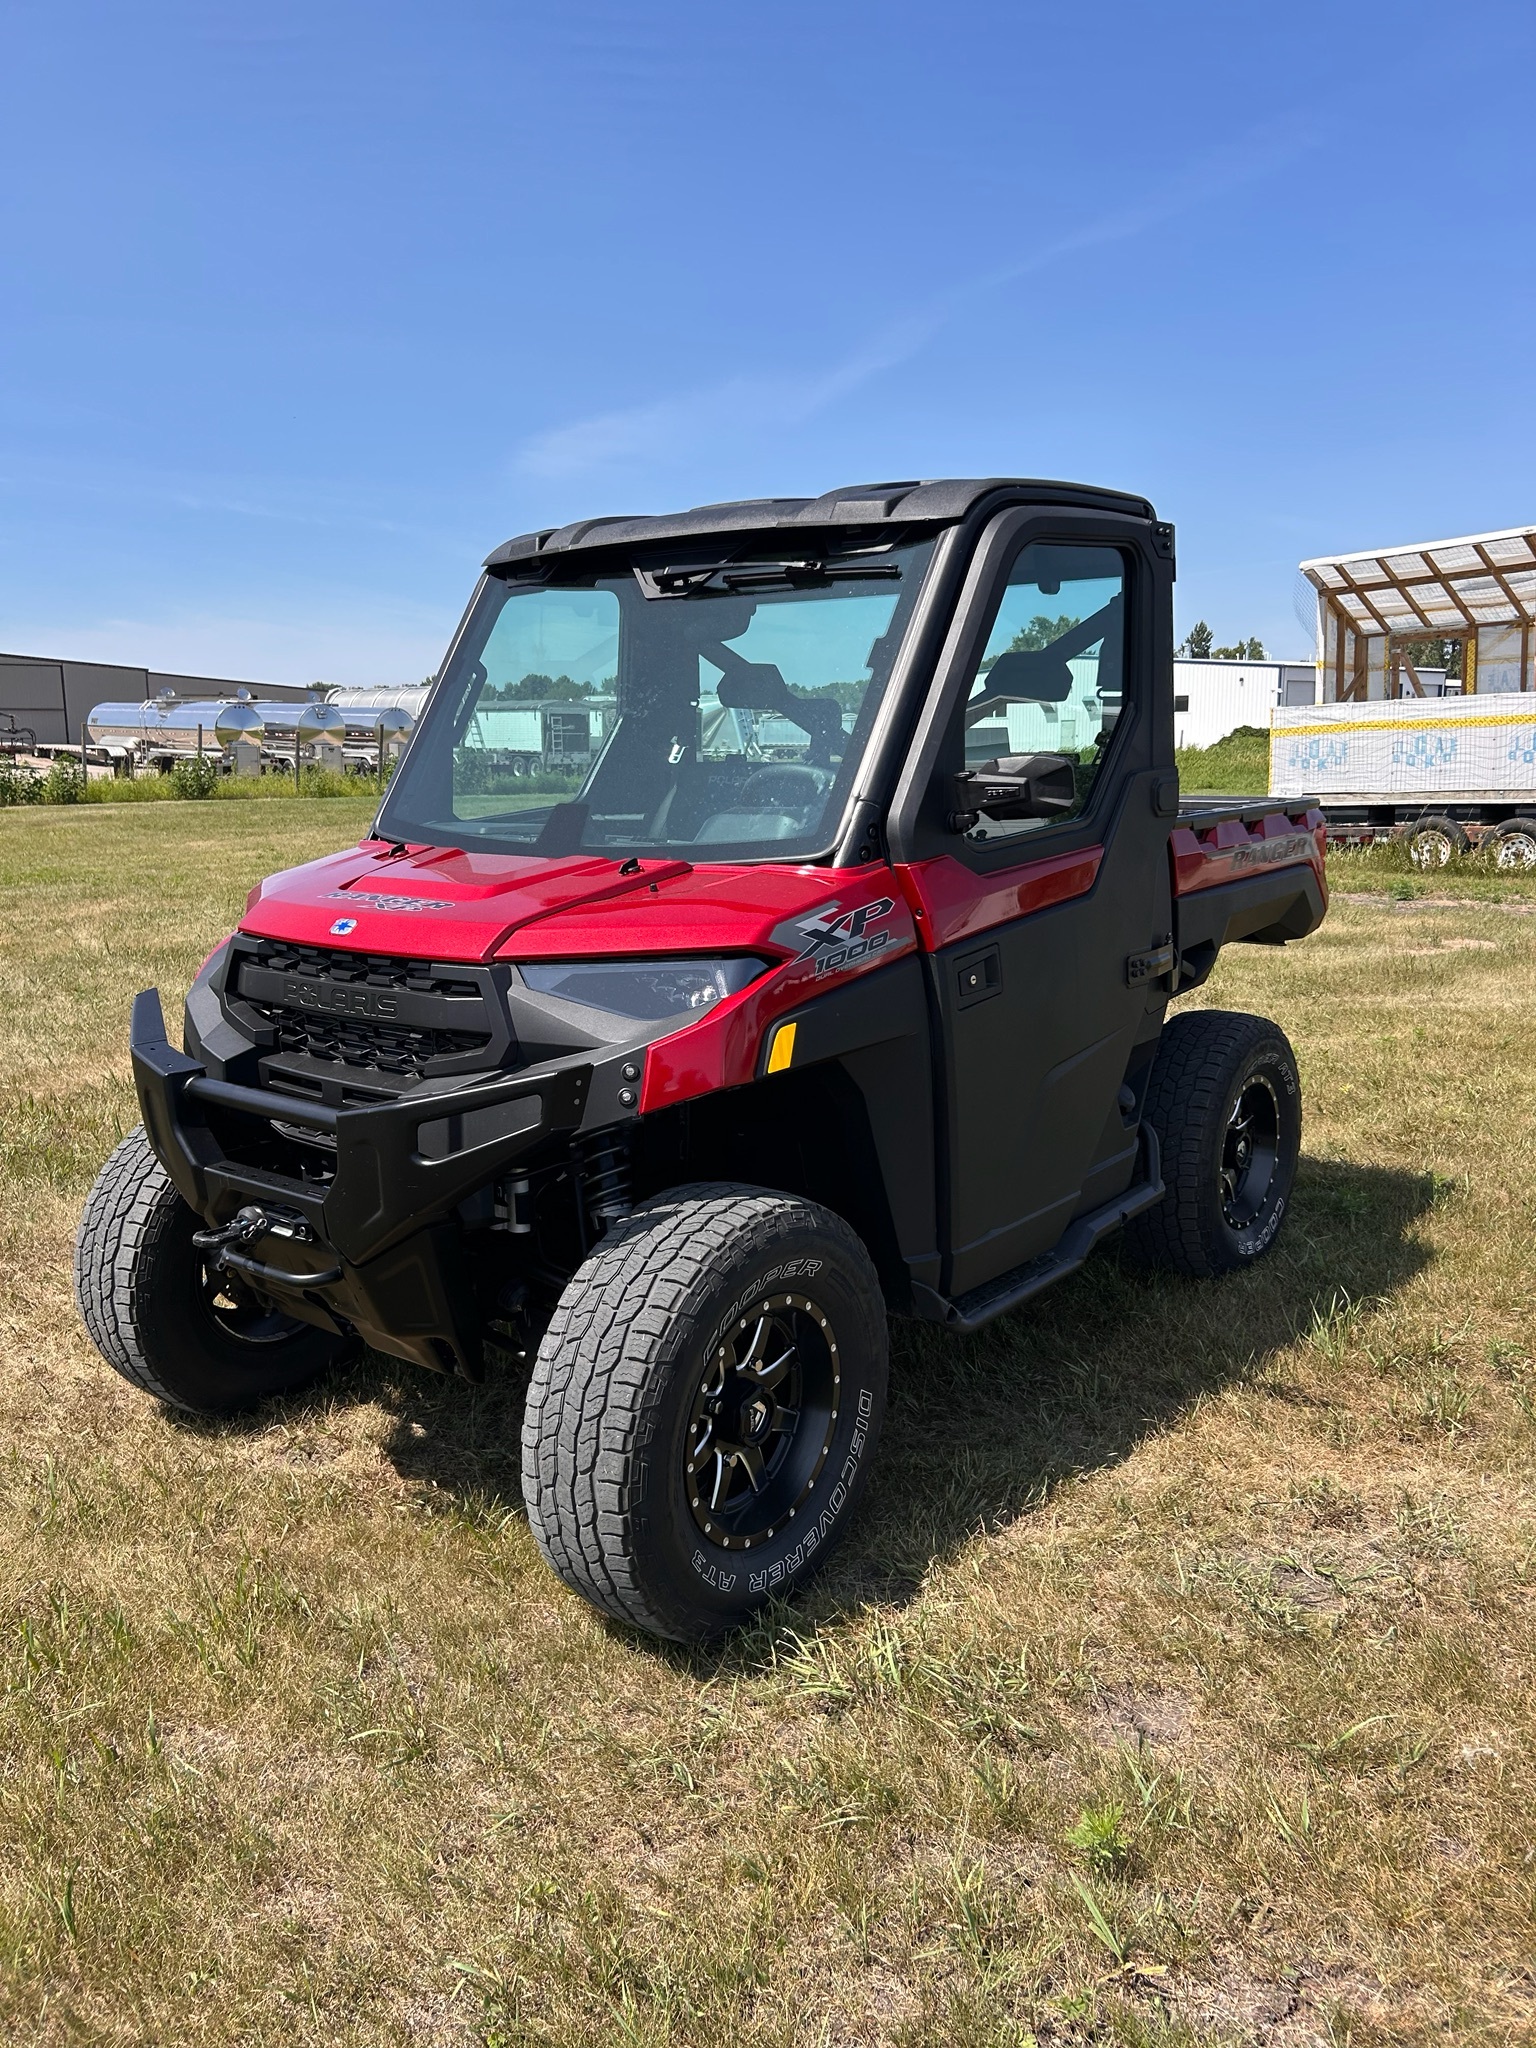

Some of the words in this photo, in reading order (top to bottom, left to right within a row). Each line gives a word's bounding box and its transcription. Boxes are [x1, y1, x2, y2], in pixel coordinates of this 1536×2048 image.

[1230, 837, 1308, 872] RANGER
[788, 896, 896, 967] XP
[815, 929, 890, 977] 1000
[815, 970, 835, 982] DUAL
[283, 980, 400, 1019] POLARIS
[1277, 1061, 1296, 1095] AT3
[703, 1258, 823, 1367] COOPER
[749, 1388, 873, 1593] DISCOVERER
[691, 1549, 737, 1592] AT3
